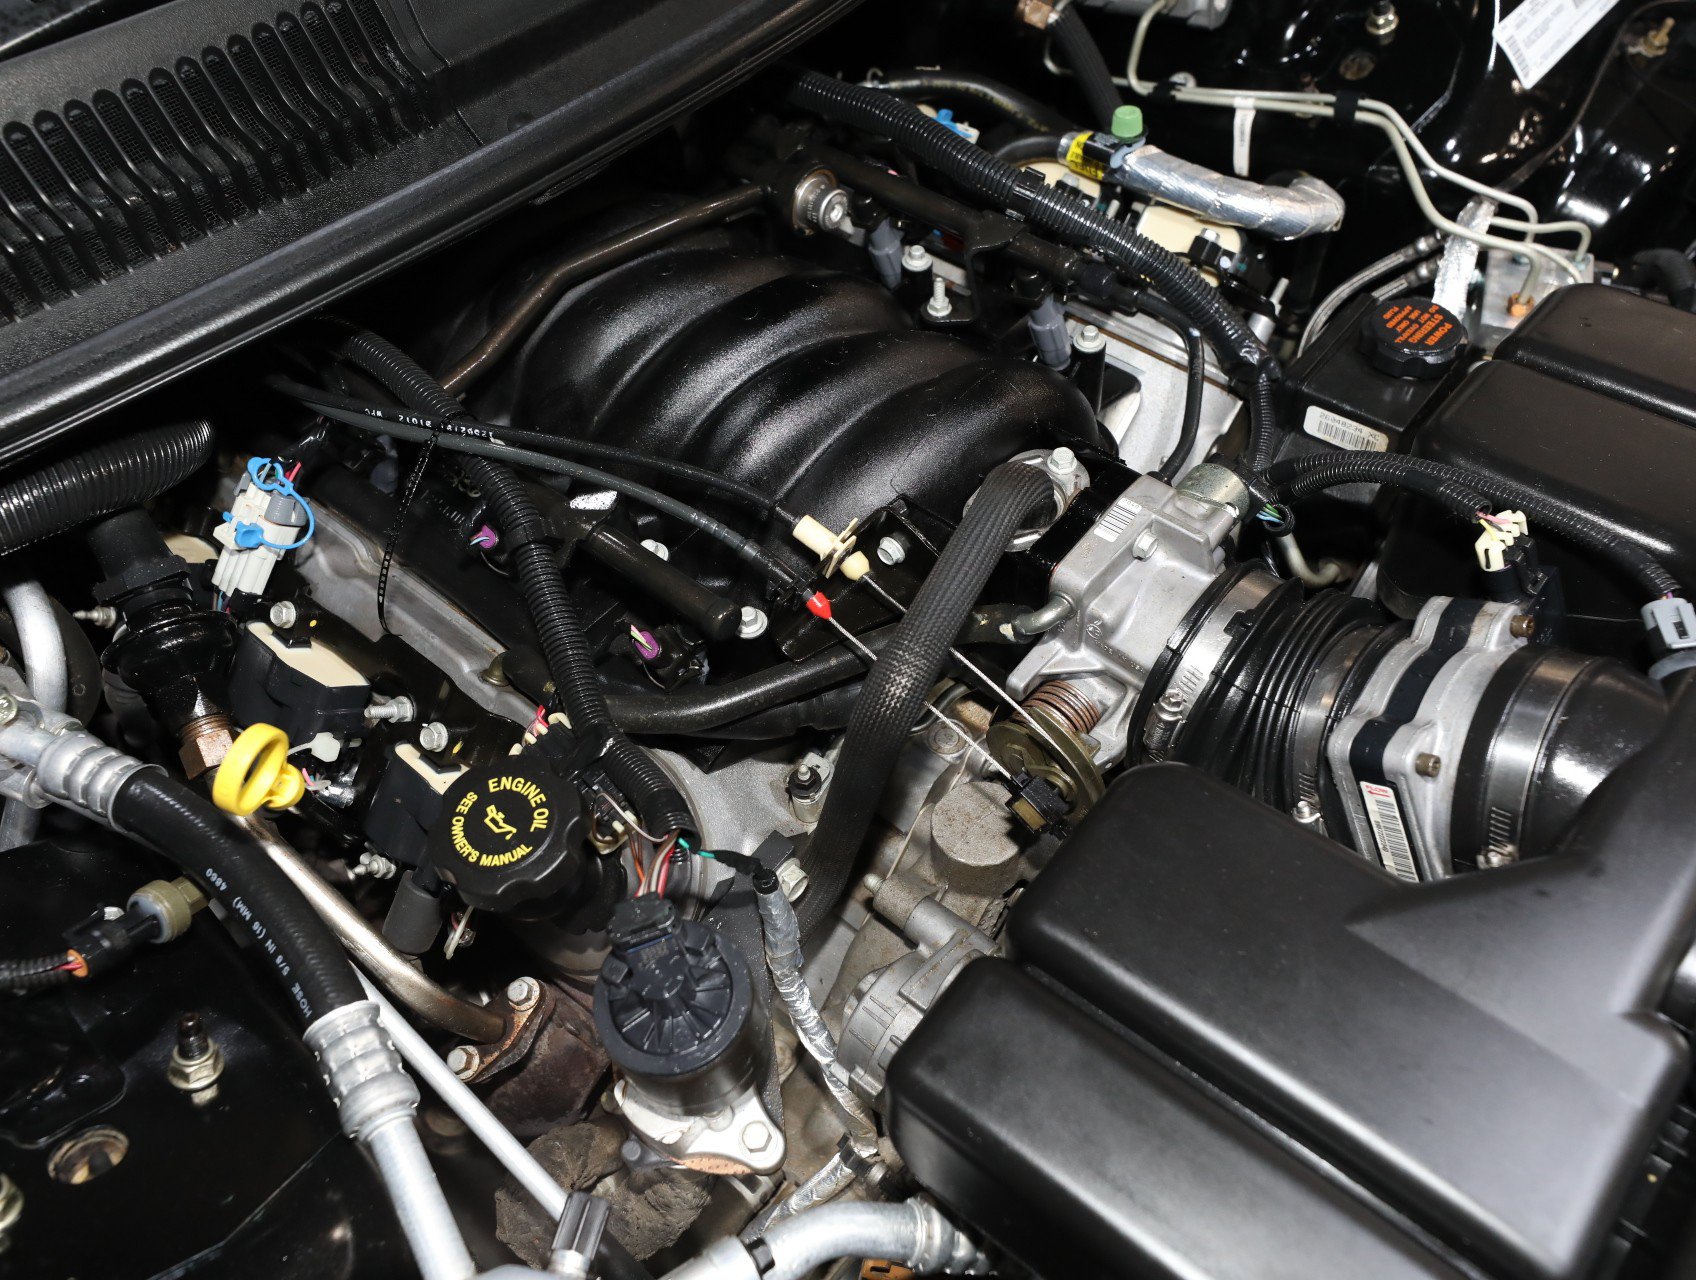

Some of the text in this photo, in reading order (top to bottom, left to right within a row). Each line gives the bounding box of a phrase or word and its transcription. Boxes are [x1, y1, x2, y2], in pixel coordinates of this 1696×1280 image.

[1382, 305, 1400, 320] FLUID
[1385, 305, 1413, 329] APPROVED
[1394, 304, 1440, 344] DO NOT OVERFILL
[1395, 320, 1410, 333] ONLY
[1408, 313, 1444, 344] STEERING
[1424, 322, 1453, 346] POWER
[487, 776, 550, 833] ENGINE OIL
[451, 791, 534, 867] SEE OWNER'S MANUAL
[232, 896, 252, 922] MM)
[251, 920, 267, 940] (16
[264, 938, 278, 955] IN
[291, 981, 313, 1019] HOSE
